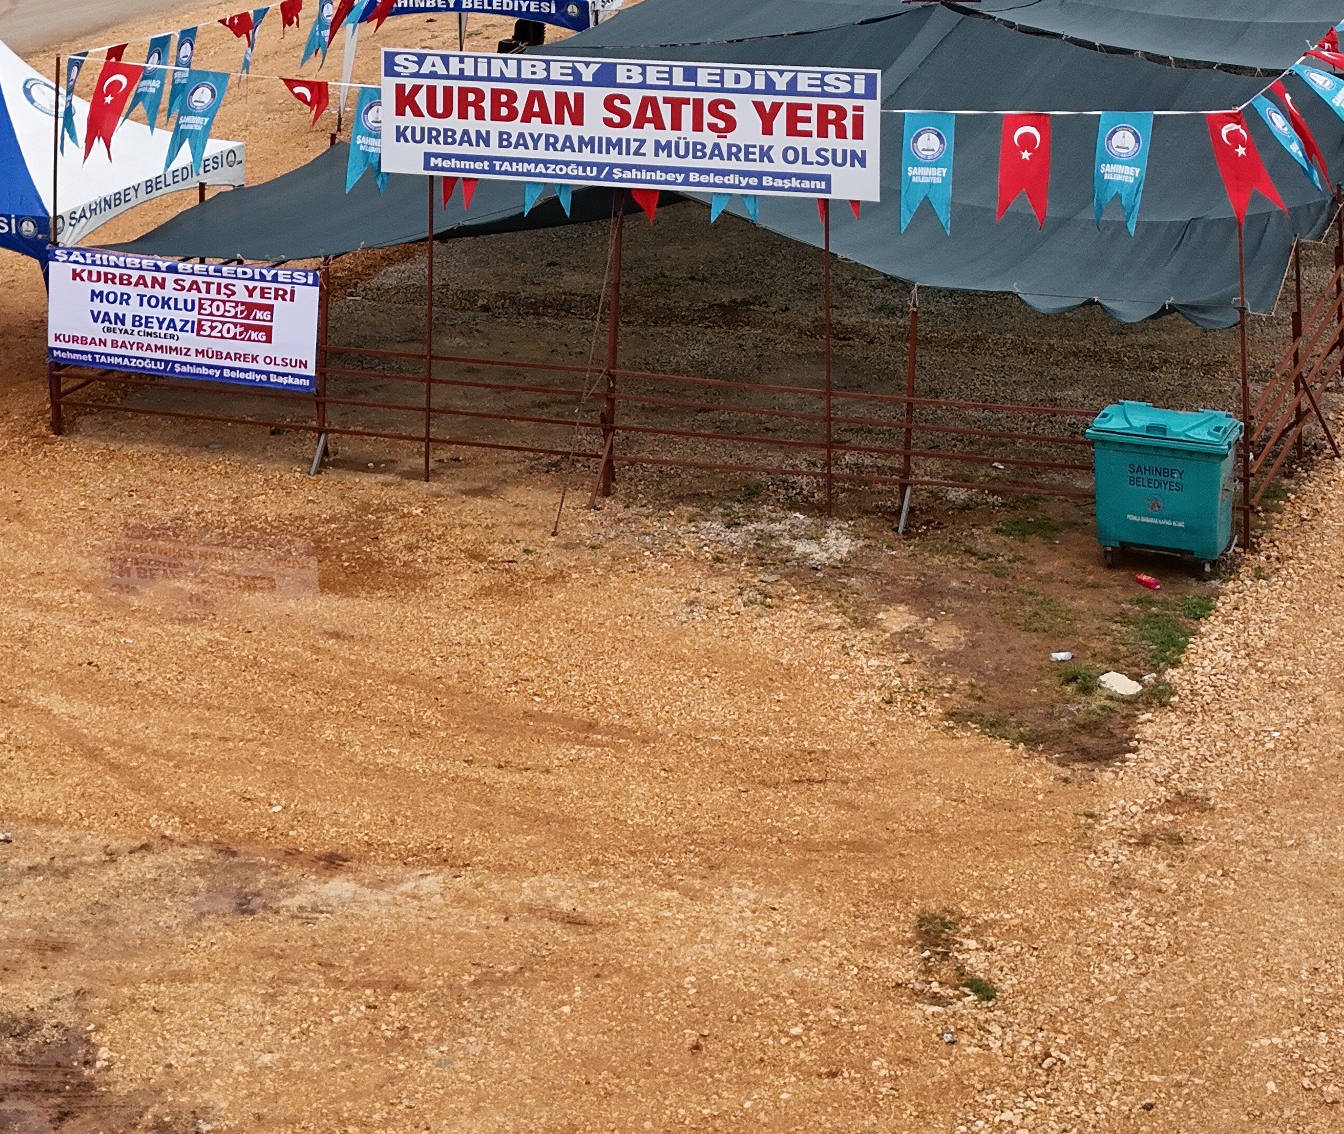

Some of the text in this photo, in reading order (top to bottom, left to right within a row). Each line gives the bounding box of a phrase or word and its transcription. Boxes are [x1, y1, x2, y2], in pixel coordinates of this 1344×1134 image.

[393, 53, 866, 95] ŞAHİNBEY BELEDİYESİ
[394, 82, 865, 141] KURBAN SATIŞ YERİ
[395, 124, 868, 169] KURBAN BAYRAMIMIZ MÜBAREK OLSUN
[68, 150, 225, 229] ŞAHİNBEY BELEDİESİ
[430, 156, 826, 191] Mehmet TAHMAZOĞLU / Şahinbey Belediye Başkanı
[70, 267, 296, 303] KURBAN SATIŞ YERİ
[89, 288, 132, 307] MOR
[136, 292, 197, 313] TOKLU
[89, 309, 128, 328] VAN
[131, 313, 196, 334] BEYAZI
[101, 325, 180, 342] (BEYAZ CİNSLER)
[52, 349, 93, 363] Mehmet
[93, 353, 166, 371] TAHMAZOĞLU
[174, 362, 222, 379] Şahinbey
[223, 367, 268, 382] Belediye
[269, 373, 311, 387] Başkanı
[53, 332, 309, 370] KURBAN BAYRAMIMIZ MÜBAREK OLSUN
[1128, 463, 1185, 480] ŞAHİNBEY
[1128, 475, 1184, 493] BELEDİYESİ
